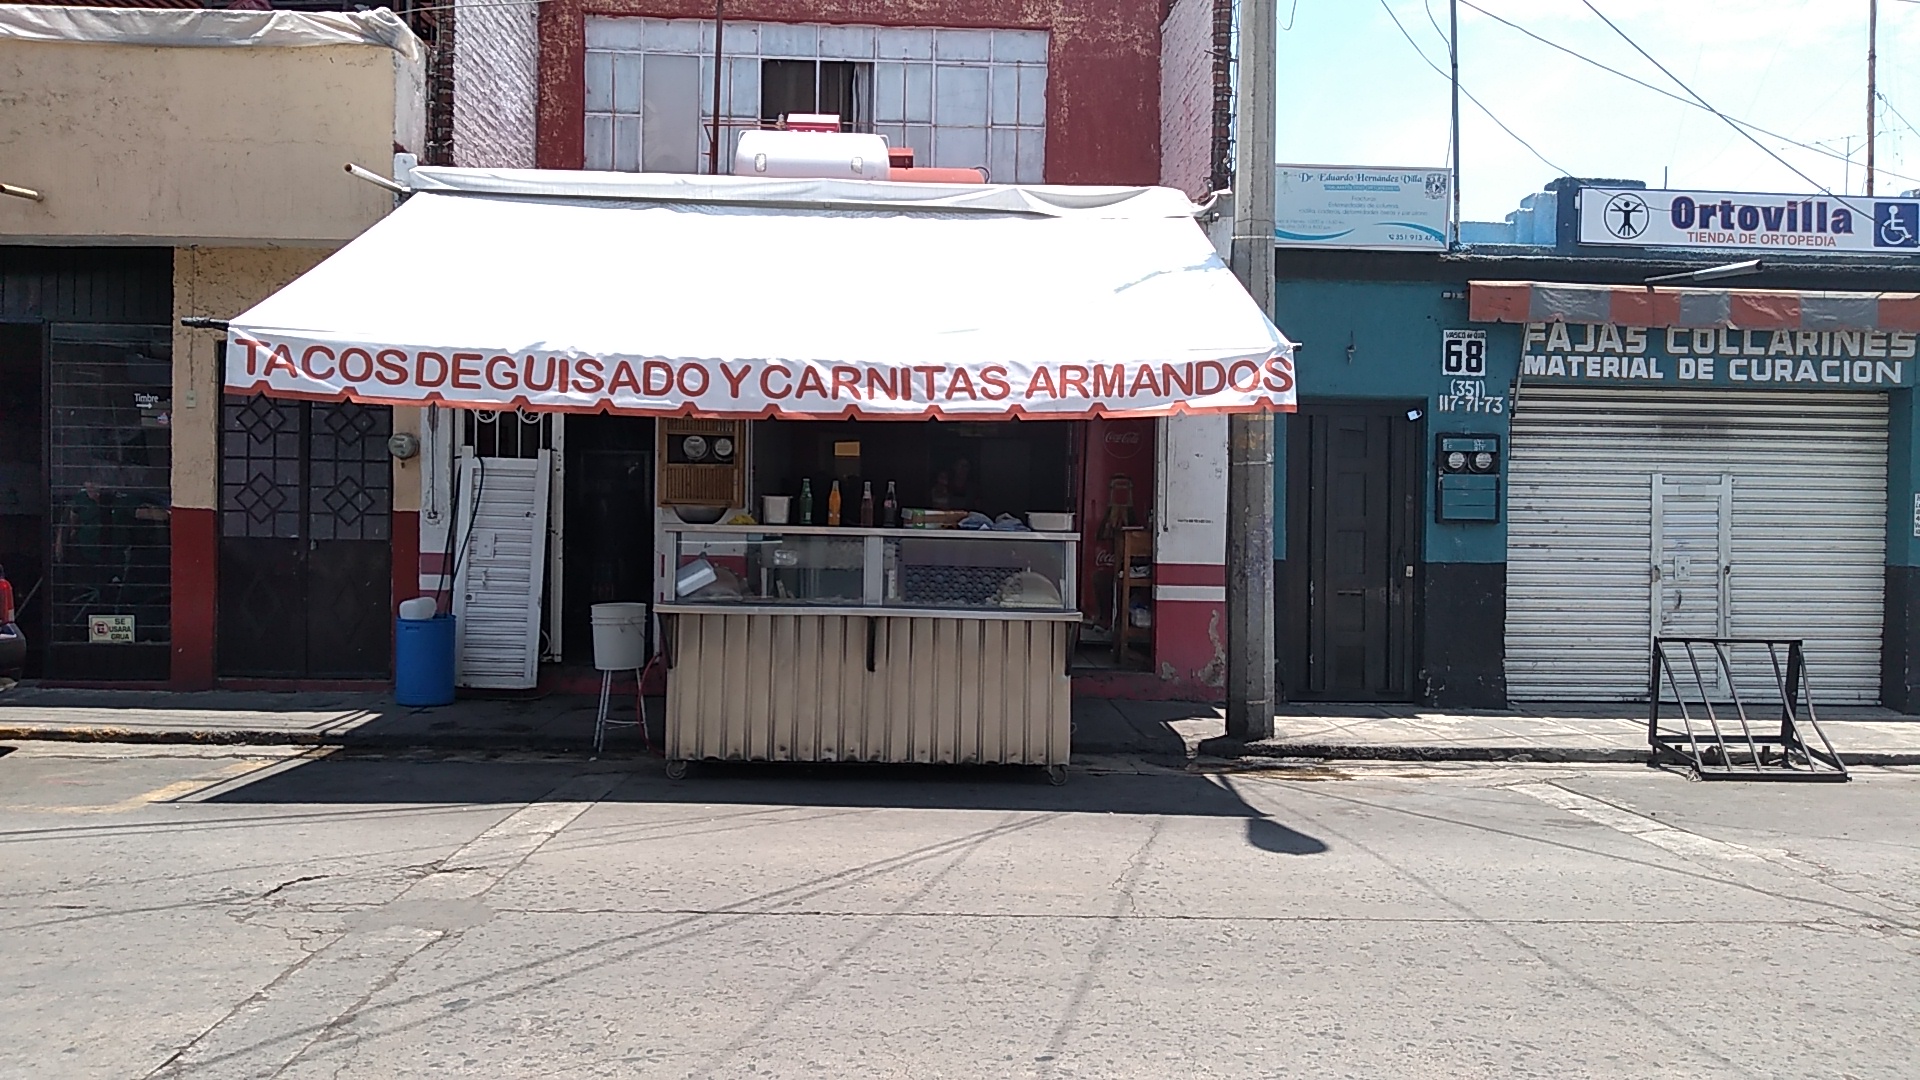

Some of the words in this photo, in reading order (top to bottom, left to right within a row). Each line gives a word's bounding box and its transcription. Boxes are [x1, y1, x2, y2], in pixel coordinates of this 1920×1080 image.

[1318, 172, 1354, 182] Eduardo
[1400, 173, 1423, 184] Villa
[1671, 195, 1854, 235] Ortovilla
[1687, 231, 1736, 244] TIENDA
[1739, 232, 1757, 244] DE
[1760, 233, 1837, 247] ORTOPEDIA
[1526, 323, 1648, 354] FAJAS
[1666, 325, 1916, 358] COLLARINES
[1445, 339, 1483, 373] 68
[719, 362, 751, 398] Y
[759, 363, 1011, 401] CARNITAS
[1024, 356, 1294, 399] ARMANDOS
[1524, 355, 1664, 379] MATERIAL
[1678, 357, 1714, 380] DE
[1729, 358, 1902, 384] CURACION
[134, 393, 160, 403] Timbre
[1450, 379, 1486, 398] (351)
[1439, 394, 1504, 414] 117-71-73
